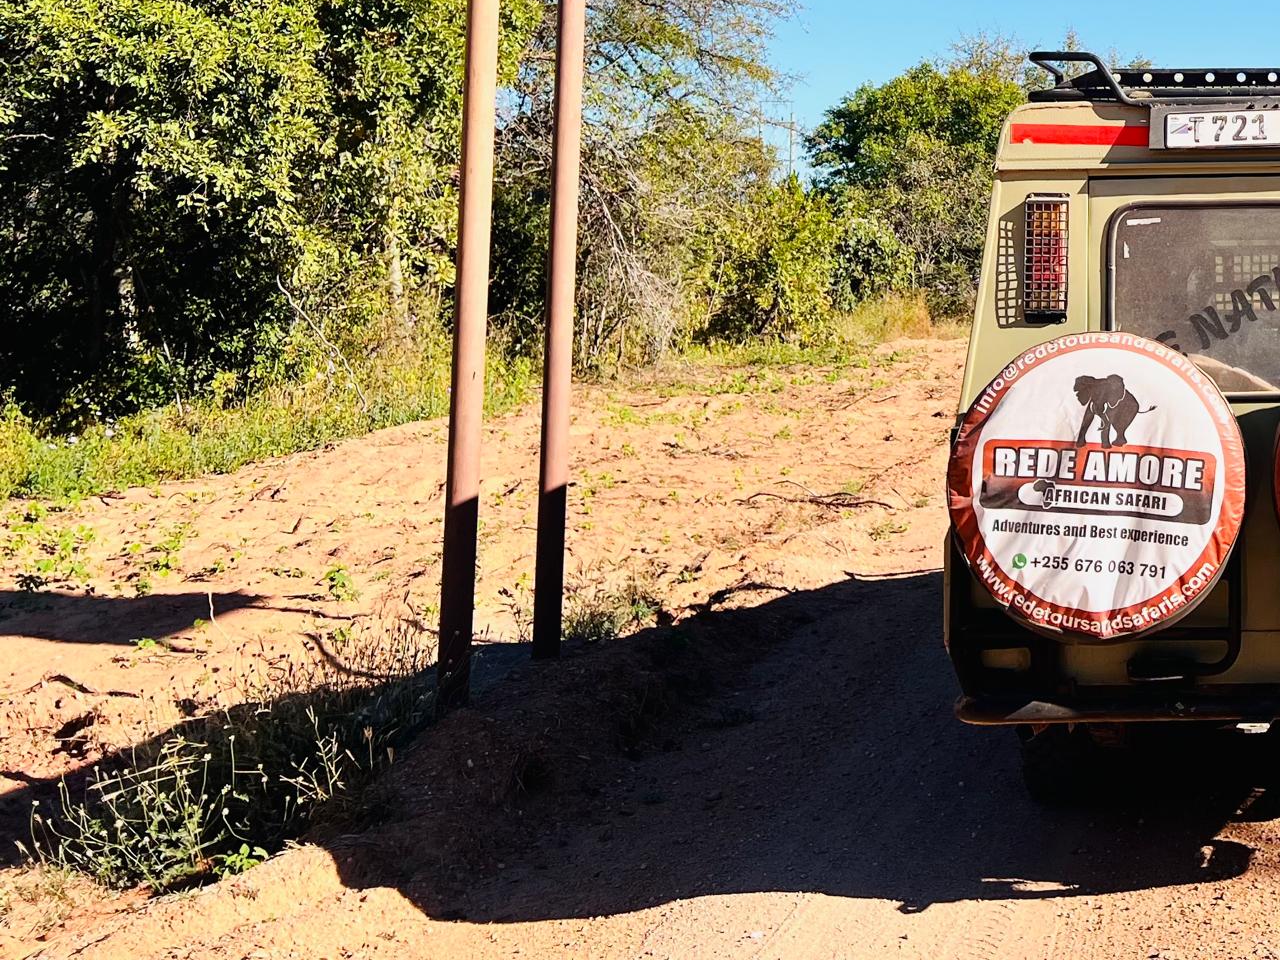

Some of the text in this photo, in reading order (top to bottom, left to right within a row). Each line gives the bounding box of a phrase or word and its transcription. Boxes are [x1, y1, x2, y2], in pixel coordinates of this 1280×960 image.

[994, 447, 1204, 491] REDE AMORE
[1043, 488, 1167, 511] AFRICAN SAFARI
[992, 519, 1189, 548] Adventures and Best experience
[1030, 555, 1167, 580] +255 676 063 791
